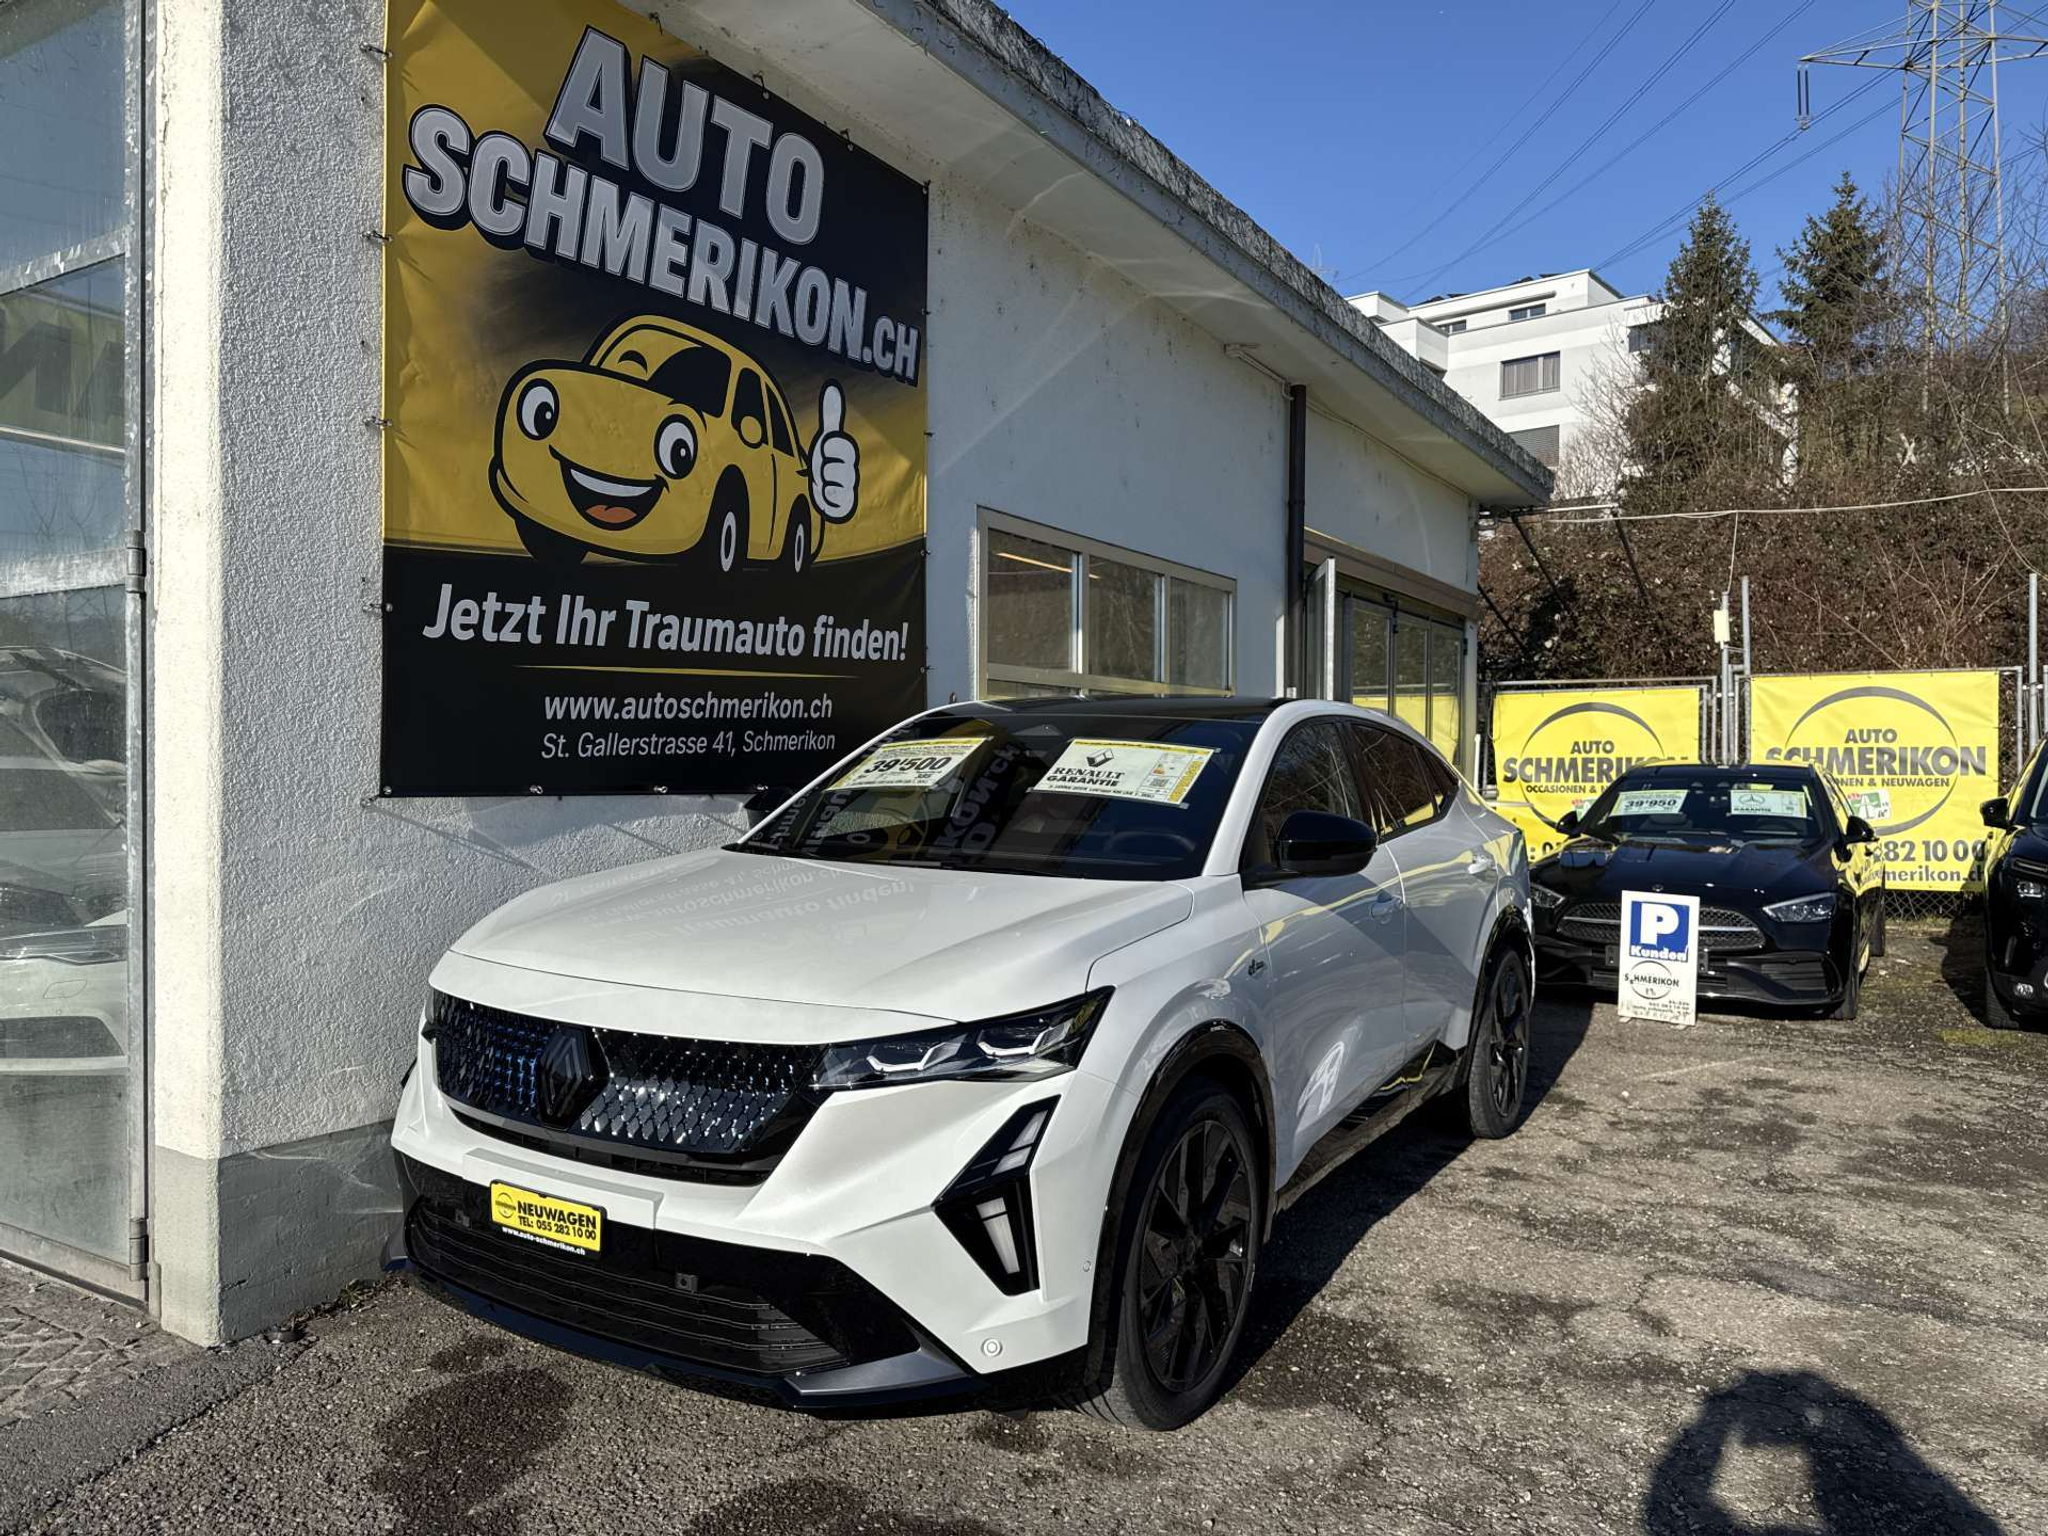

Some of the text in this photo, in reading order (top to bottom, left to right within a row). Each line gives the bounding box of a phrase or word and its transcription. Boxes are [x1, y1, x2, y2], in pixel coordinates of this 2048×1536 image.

[545, 26, 826, 246] AUTO
[404, 107, 921, 383] SCHMERIKON.CH
[422, 583, 909, 661] Jetzt Ihr Traumauto finden!
[544, 691, 833, 721] www.autoschmerikon.ch
[541, 729, 836, 759] St. Gallerstrasse 41, Schmerikon
[1570, 740, 1615, 755] AUTO
[1845, 729, 1898, 744] AUTO
[864, 757, 952, 774] 39'500
[1053, 767, 1125, 780] RENAULT
[1503, 756, 1690, 784] SCHMERI
[1047, 775, 1120, 787] GARANTIE
[1526, 784, 1586, 794] OCCASIONEN
[1589, 784, 1597, 794] &
[1868, 778, 1877, 787] &
[1882, 778, 1950, 787] NEUWAGEN
[1922, 840, 1948, 862] 10
[517, 1200, 597, 1229] NEUWAGEN
[518, 1215, 597, 1241] TEL: 055 282 10 00
